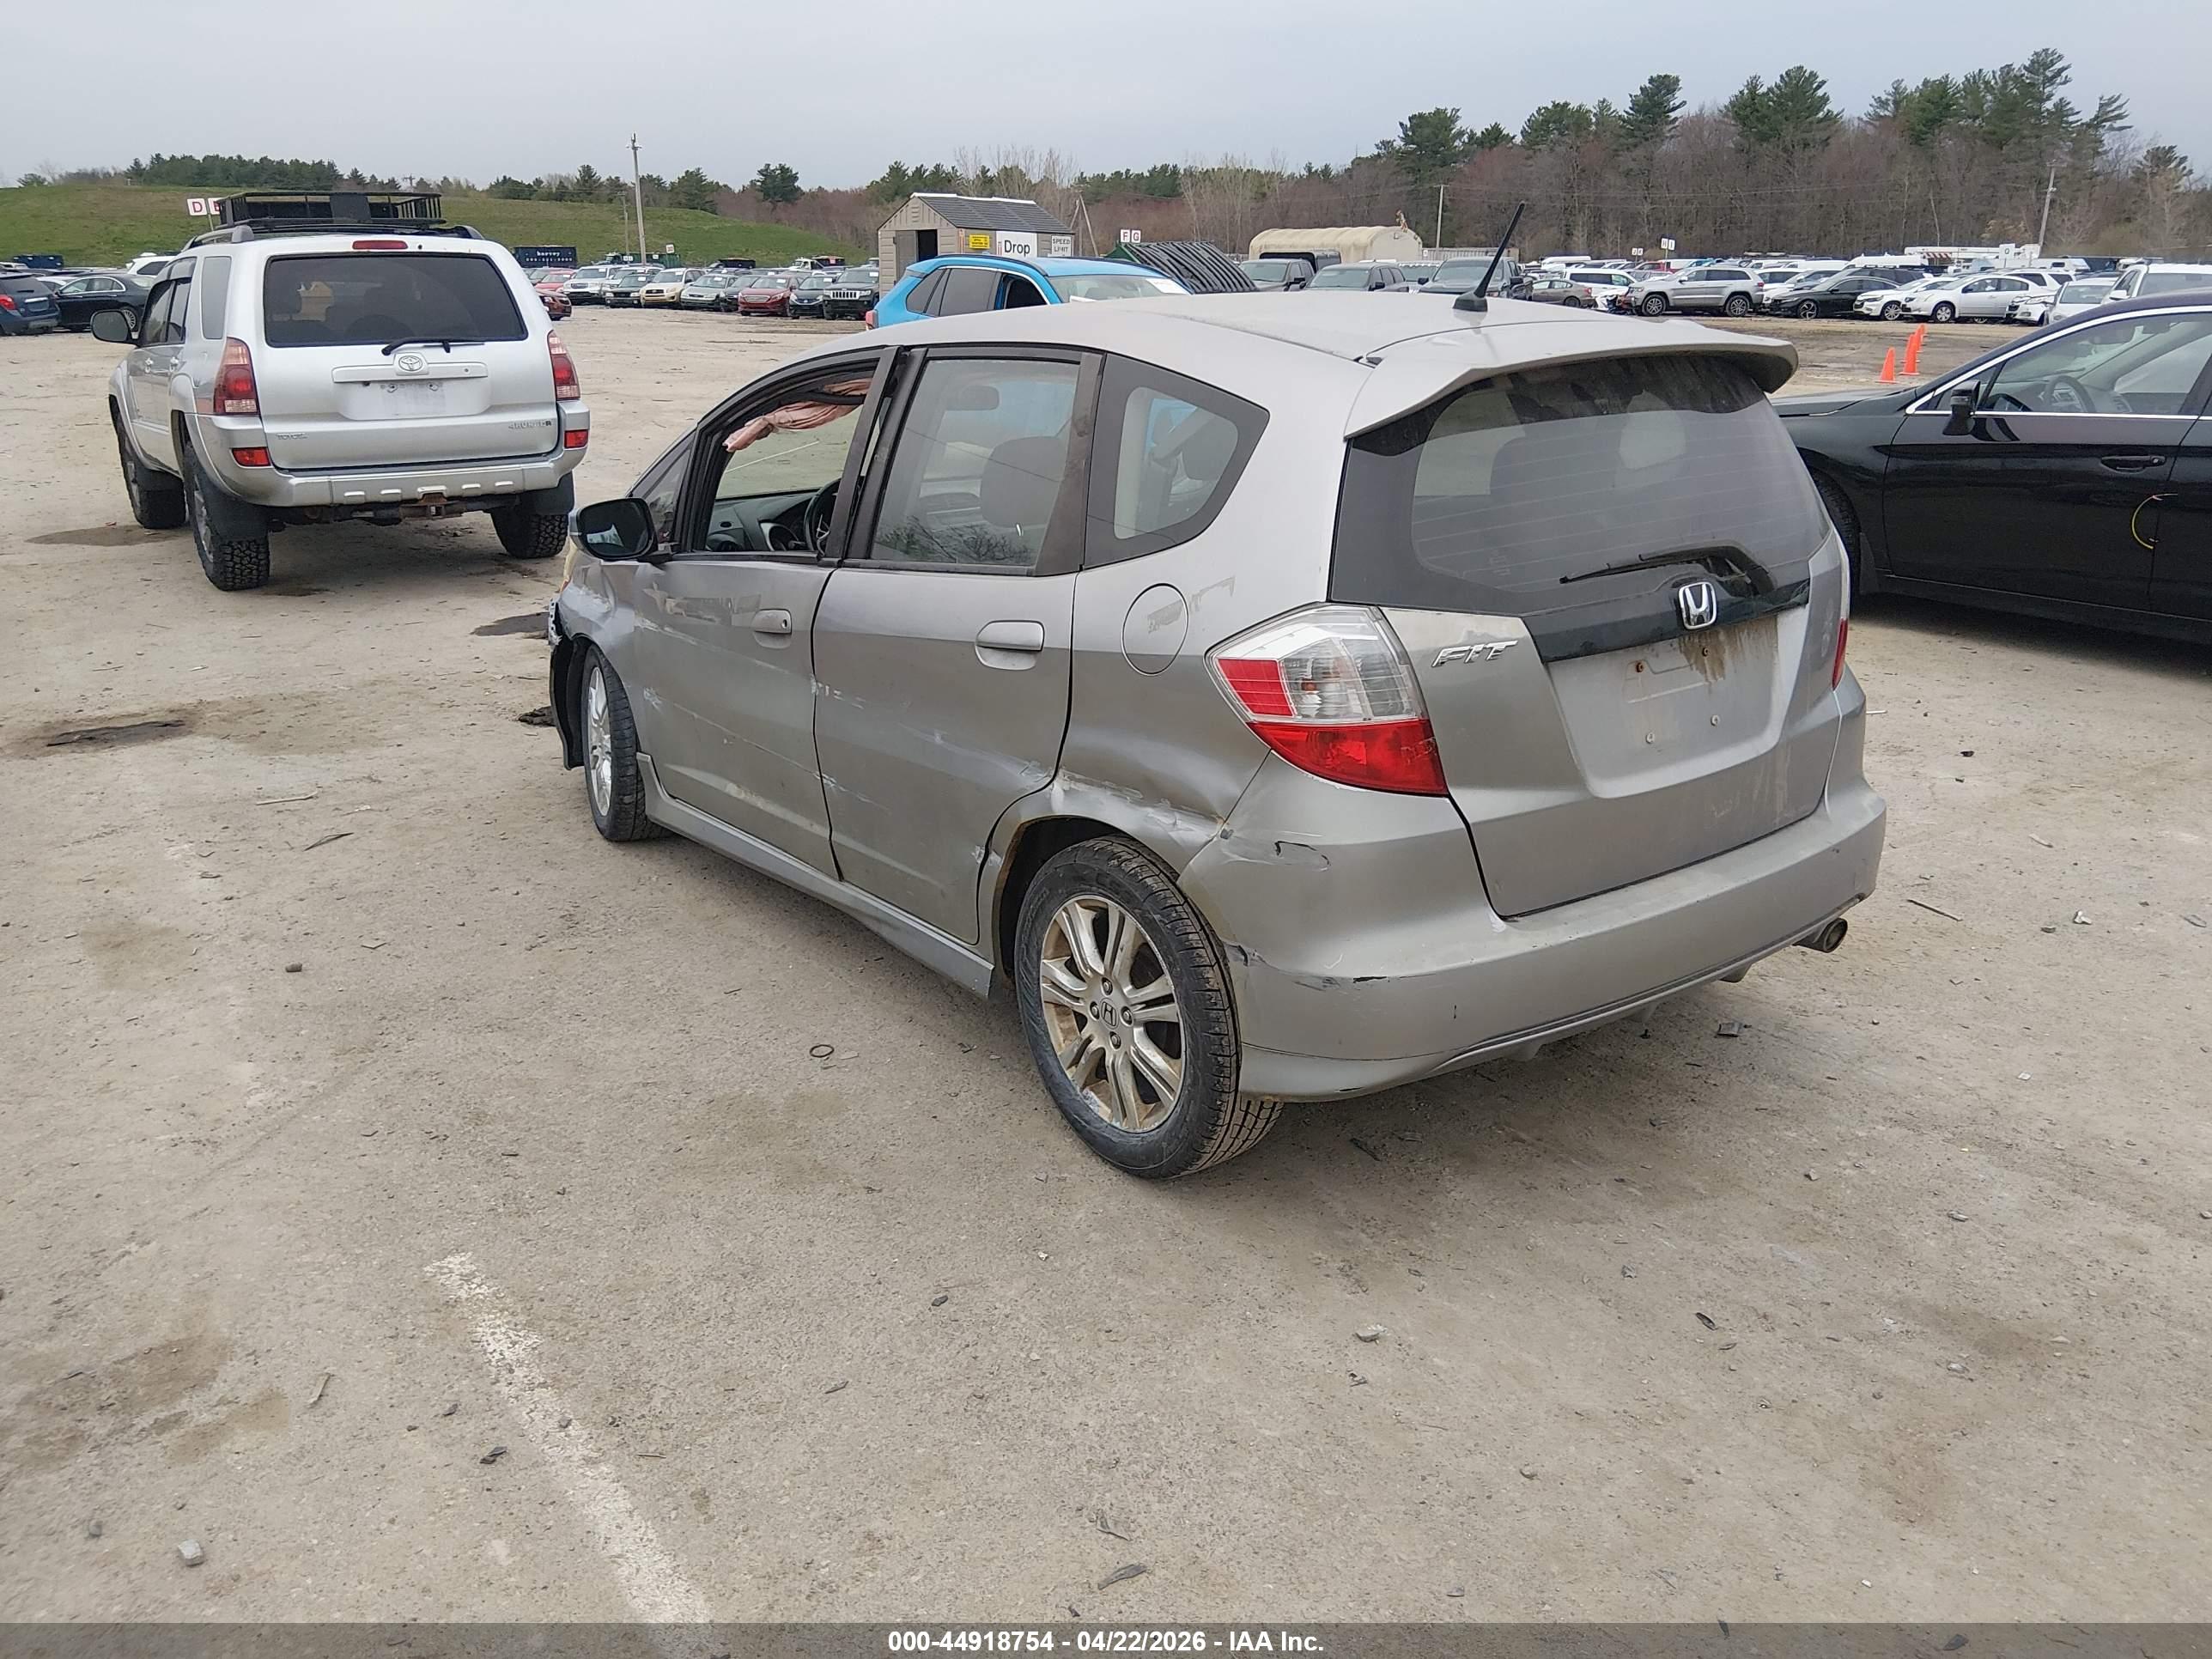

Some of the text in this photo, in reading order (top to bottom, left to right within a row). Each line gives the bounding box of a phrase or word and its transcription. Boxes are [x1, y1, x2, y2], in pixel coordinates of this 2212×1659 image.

[191, 201, 203, 213] D
[1122, 231, 1139, 241] F G
[1004, 240, 1030, 257] Drop
[1431, 640, 1519, 667] FIT
